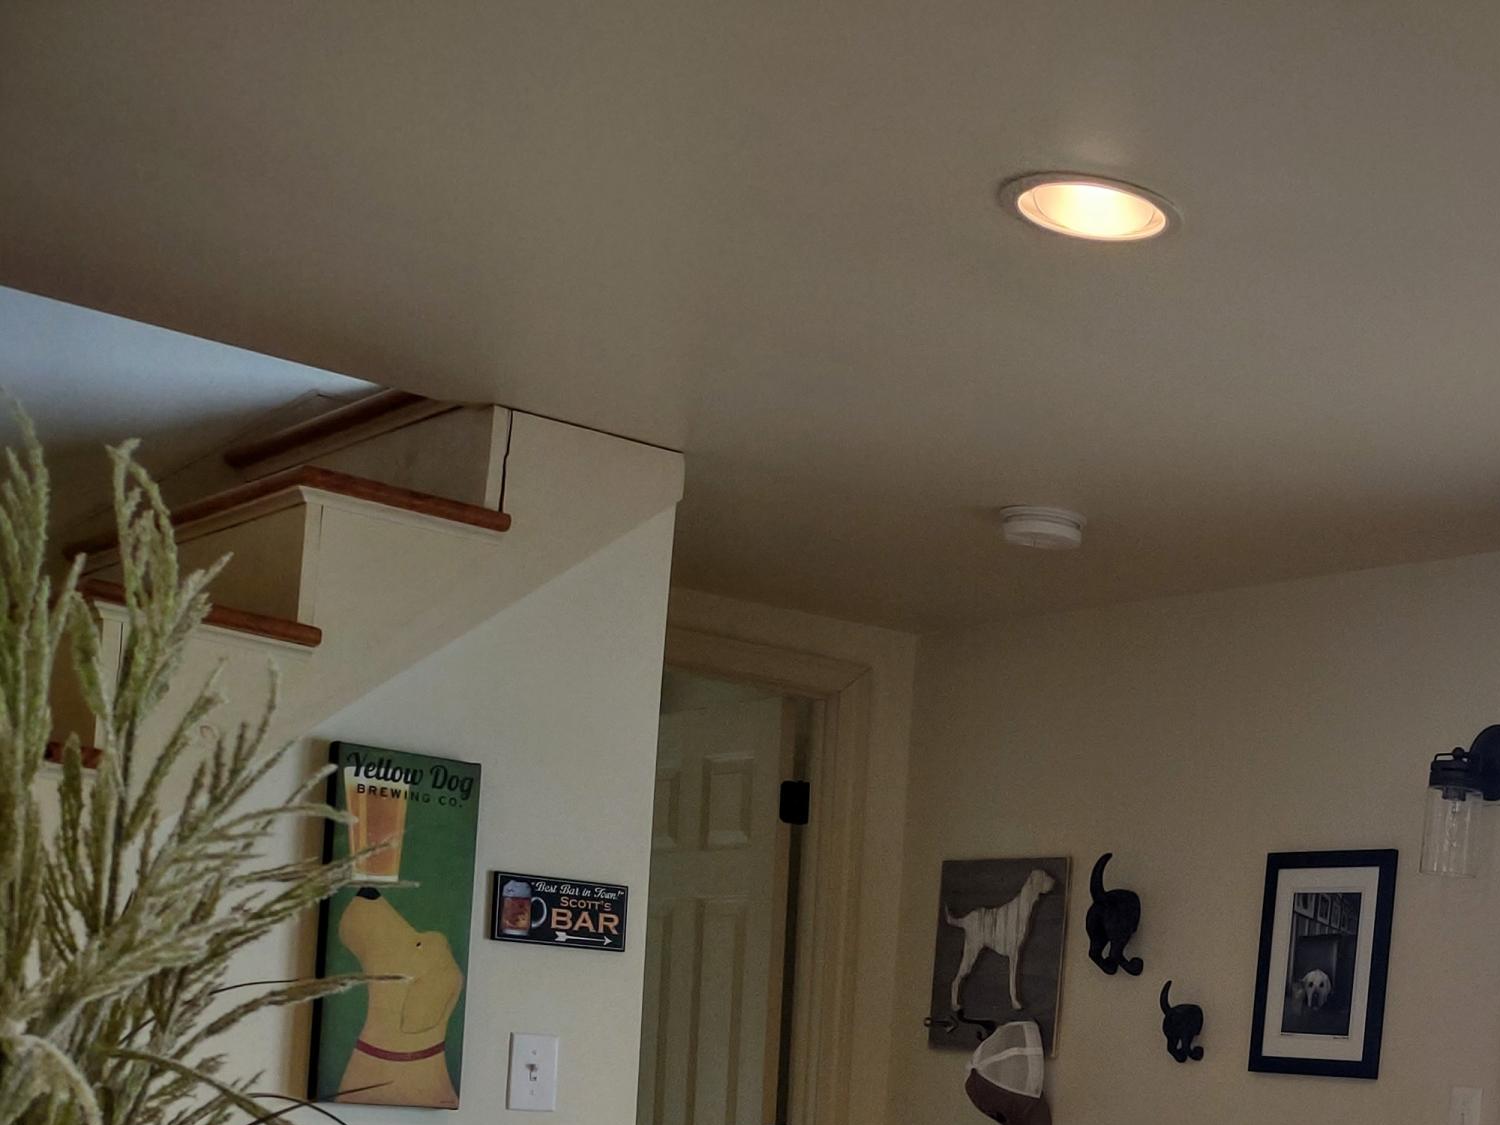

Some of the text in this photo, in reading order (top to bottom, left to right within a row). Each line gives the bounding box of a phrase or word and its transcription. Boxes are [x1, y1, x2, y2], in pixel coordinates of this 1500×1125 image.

[347, 752, 474, 800] Yellow Dog
[357, 784, 463, 808] BREWING CO.
[560, 884, 581, 896] Bar
[582, 887, 592, 898] in
[560, 896, 612, 912] SCOTT'S
[551, 908, 620, 935] BAR
